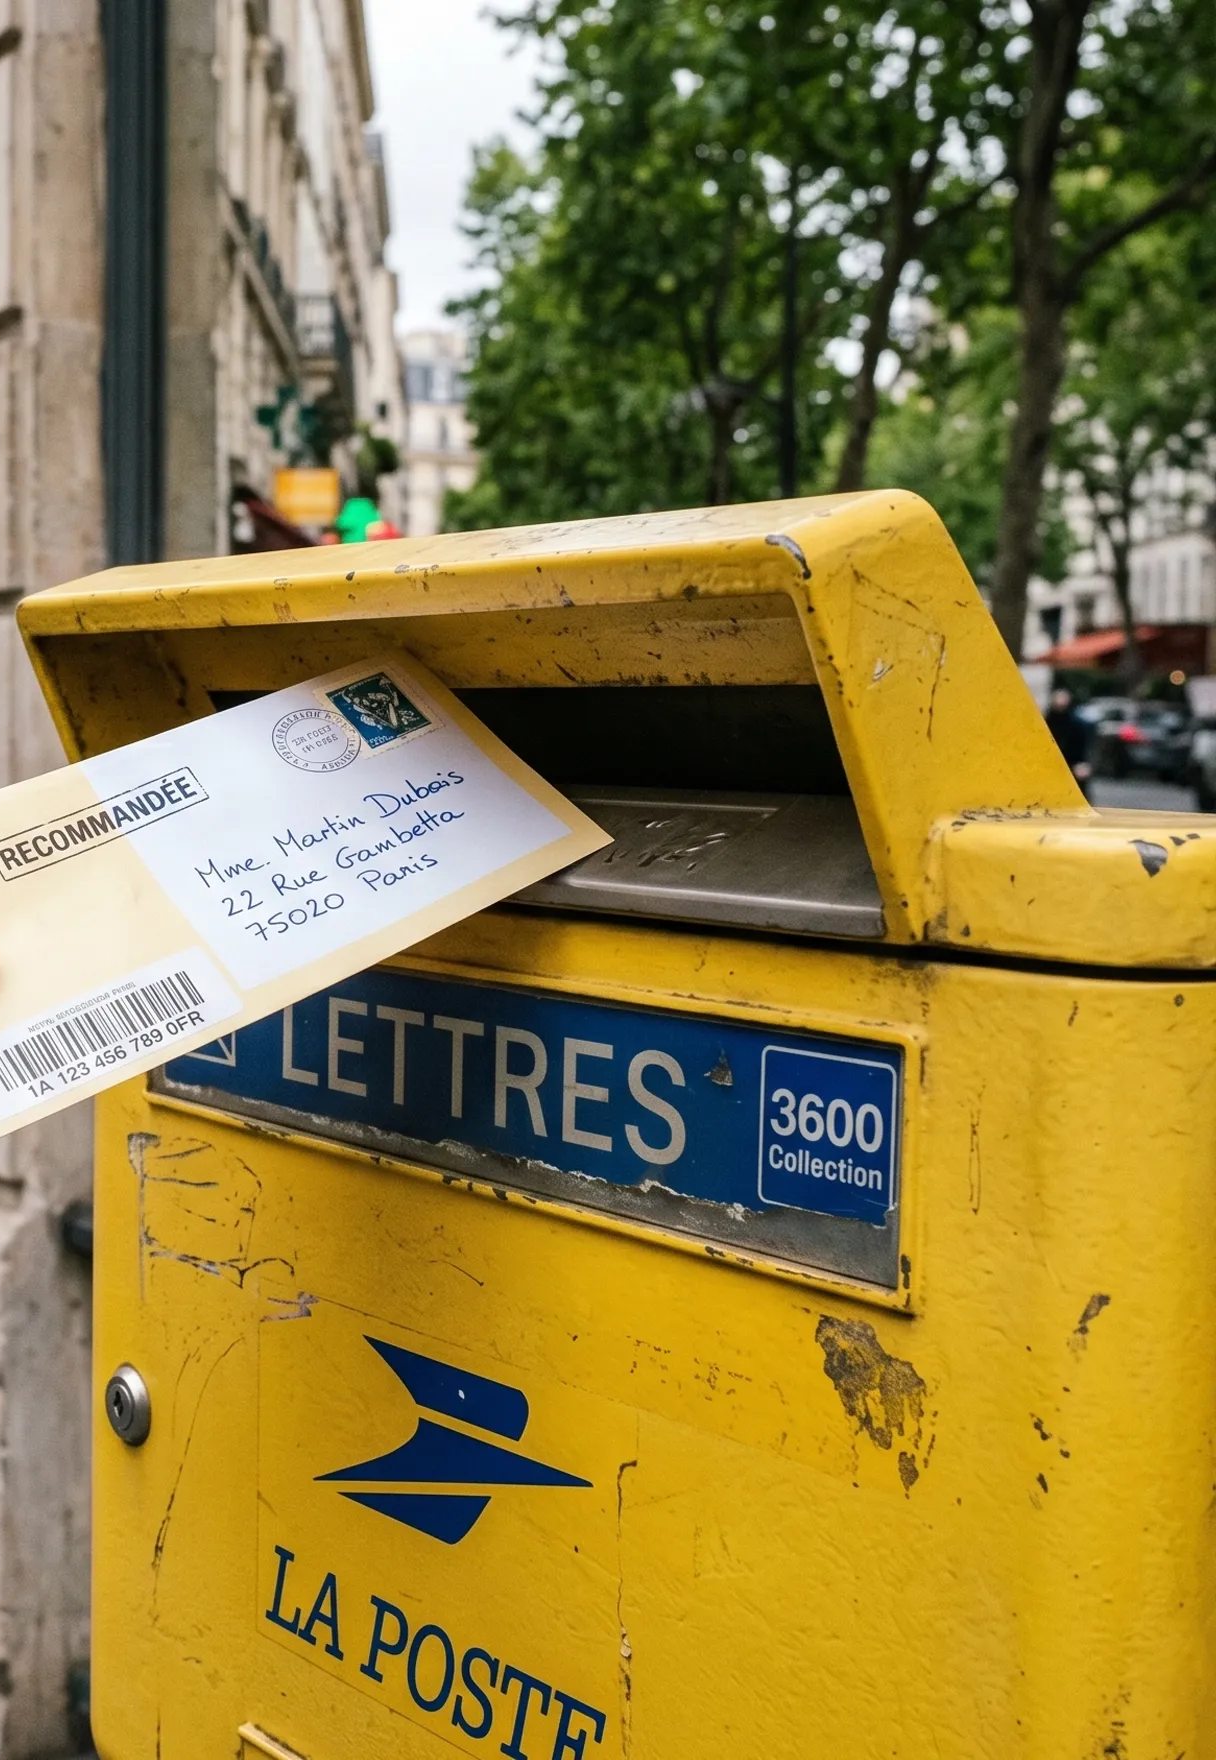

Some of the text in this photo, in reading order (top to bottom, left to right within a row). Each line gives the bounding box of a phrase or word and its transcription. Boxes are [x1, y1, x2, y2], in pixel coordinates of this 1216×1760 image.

[0, 776, 197, 870] RECOMMANDÉE
[194, 858, 271, 888] Mme.
[273, 815, 366, 857] Martin
[222, 809, 465, 917] 22 Rue Gambetta
[244, 853, 438, 941] 75020 Paris
[57, 1062, 91, 1085] 123
[95, 1045, 127, 1069] 456
[129, 1028, 163, 1052] 789
[282, 995, 687, 1166] LETTRES
[770, 1088, 884, 1153] 3600
[768, 1143, 882, 1190] Collection
[265, 1544, 344, 1661] LA
